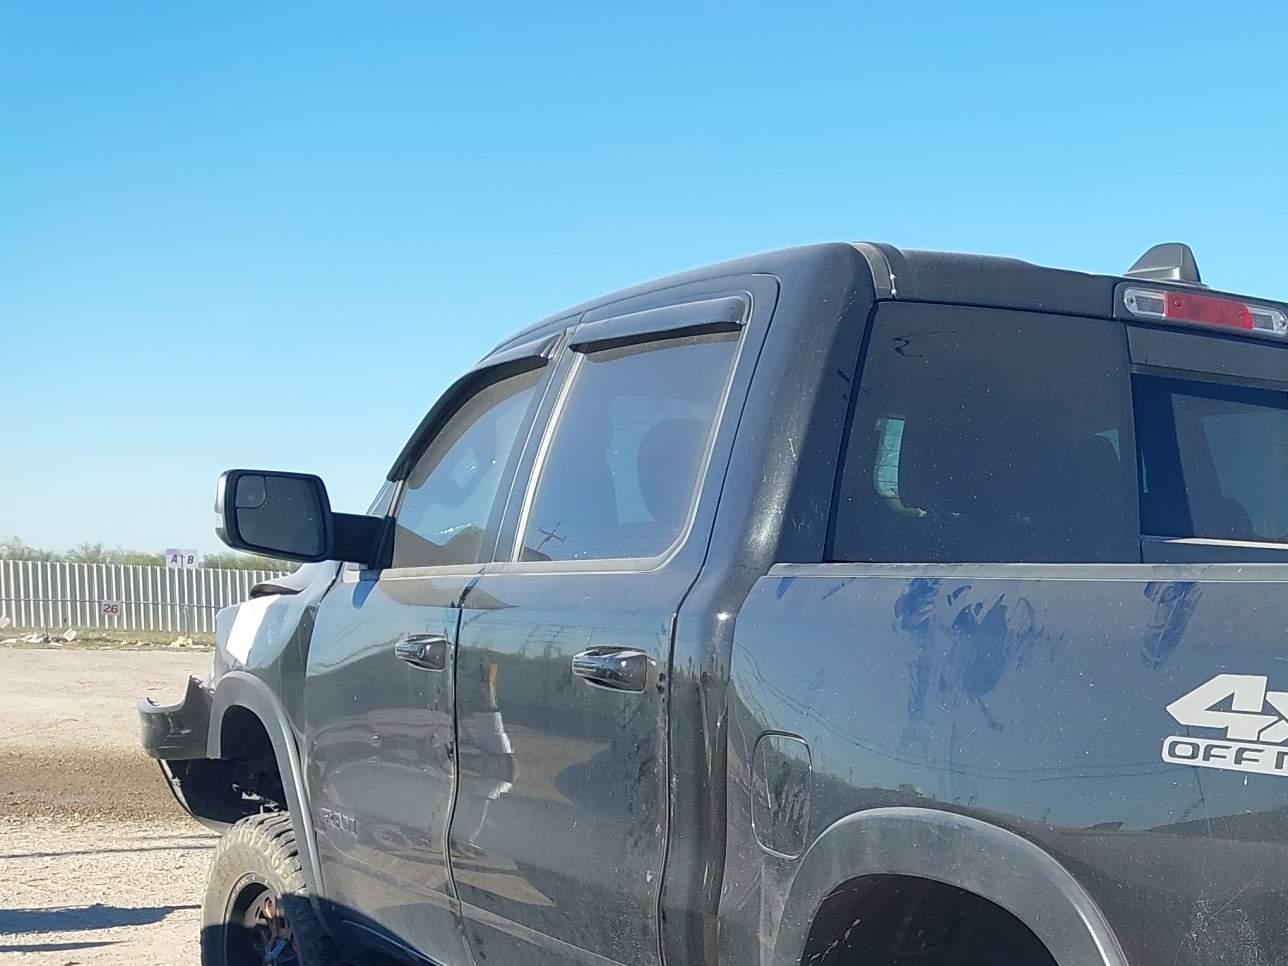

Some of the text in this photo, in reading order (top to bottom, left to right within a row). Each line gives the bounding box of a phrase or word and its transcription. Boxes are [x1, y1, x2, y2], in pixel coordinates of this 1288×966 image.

[170, 554, 178, 564] A
[187, 554, 195, 565] B
[103, 603, 119, 614] 26
[1167, 740, 1265, 766] OFF
